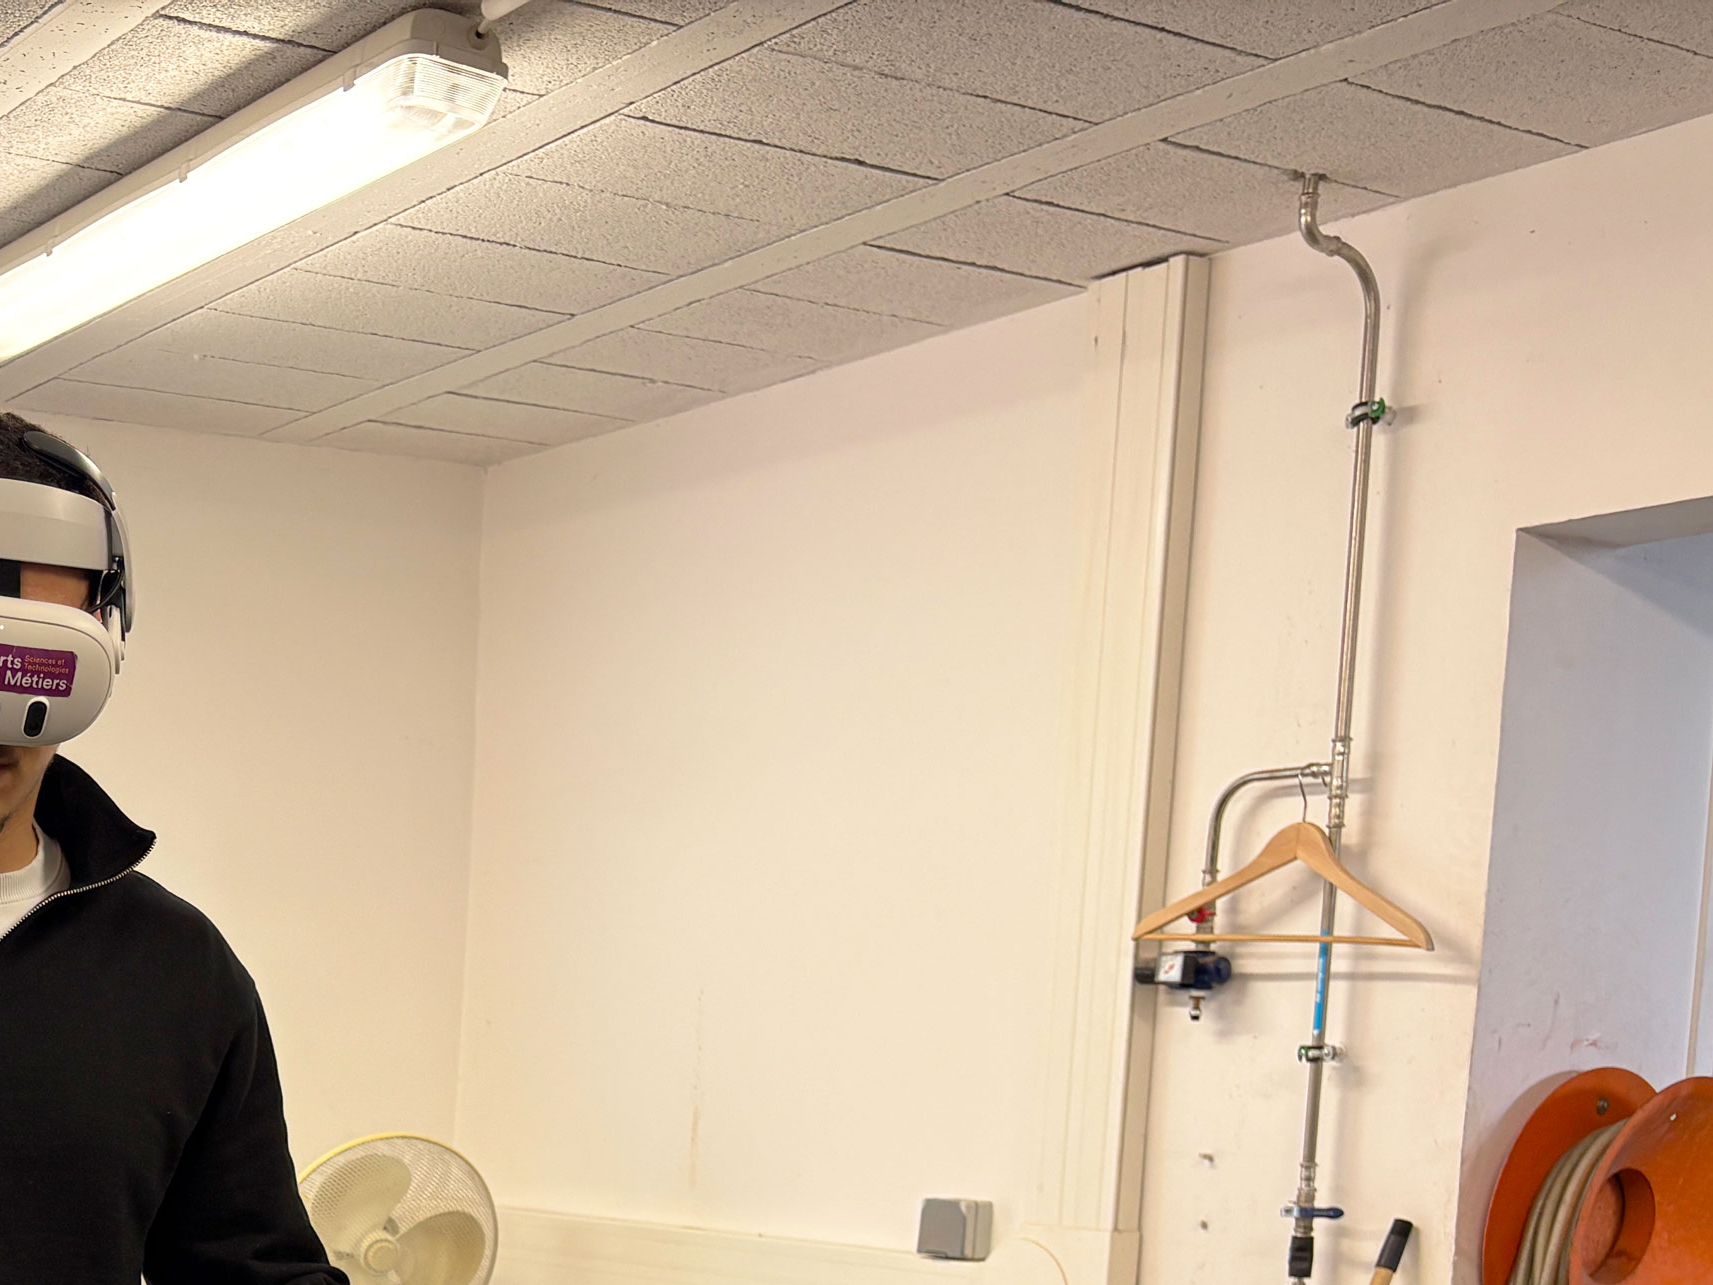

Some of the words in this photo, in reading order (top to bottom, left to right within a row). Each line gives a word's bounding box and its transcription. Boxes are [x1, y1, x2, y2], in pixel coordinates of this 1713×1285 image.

[24, 654, 56, 665] Sciences
[24, 662, 69, 674] Technologies
[4, 669, 67, 690] Métiers
